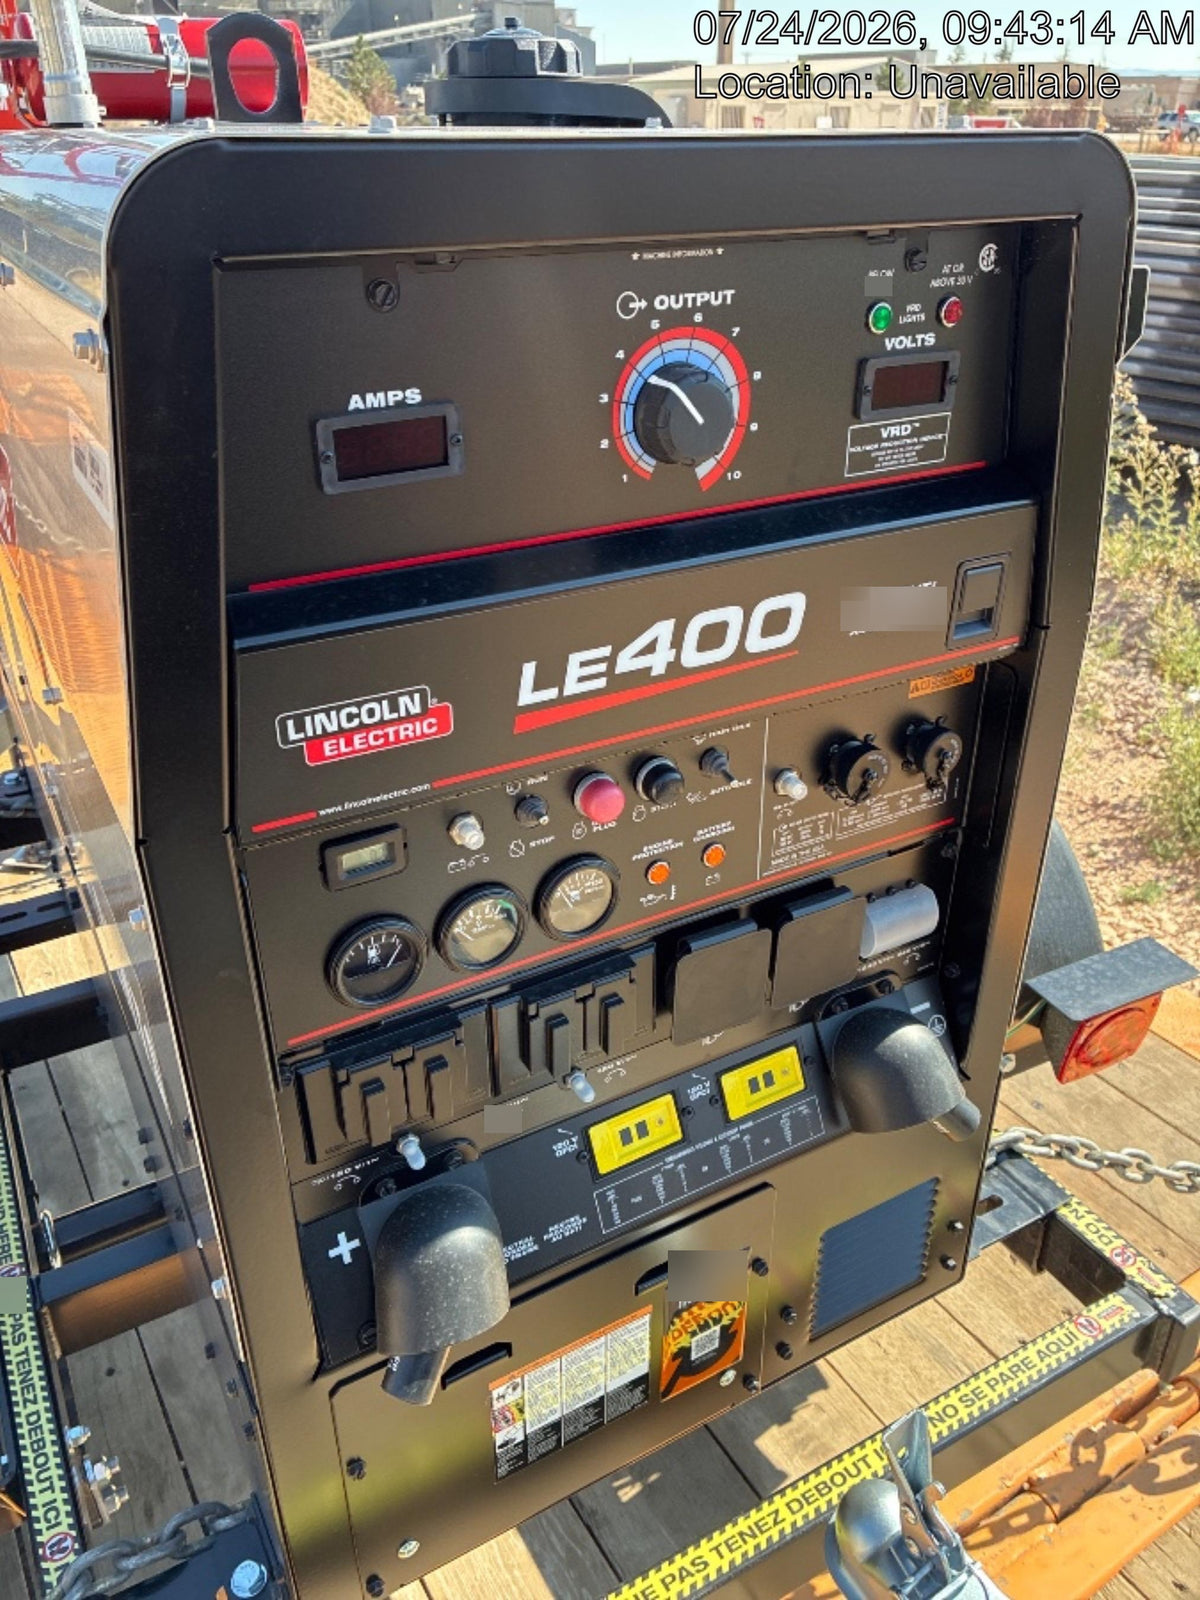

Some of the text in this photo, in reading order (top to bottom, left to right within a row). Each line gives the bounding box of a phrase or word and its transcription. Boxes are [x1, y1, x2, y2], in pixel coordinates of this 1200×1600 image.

[654, 289, 736, 310] OUTPUT
[651, 320, 661, 329] 5
[693, 313, 703, 322] 6
[731, 327, 741, 336] 7
[884, 332, 936, 351] VOLTS
[615, 350, 625, 359] 4
[753, 371, 762, 380] 8
[348, 387, 422, 411] AMPS
[599, 394, 609, 403] 3
[750, 423, 758, 431] 9
[600, 439, 609, 449] 2
[622, 474, 628, 483] 1
[727, 471, 742, 480] 10
[517, 591, 807, 707] LE400
[286, 692, 422, 742] LINCOLN
[323, 717, 438, 757] ELECTRIC
[318, 783, 431, 816] www.lincolnelectric.com
[928, 1404, 959, 1428] NO
[959, 1386, 986, 1409] SE
[985, 1355, 1037, 1392] PARE
[8, 1313, 62, 1532] PAS TENEZ DEBOUT ICI
[659, 1557, 711, 1593] PAS
[709, 1509, 787, 1561] TENEZ
[787, 1456, 880, 1515] DEBOUT
